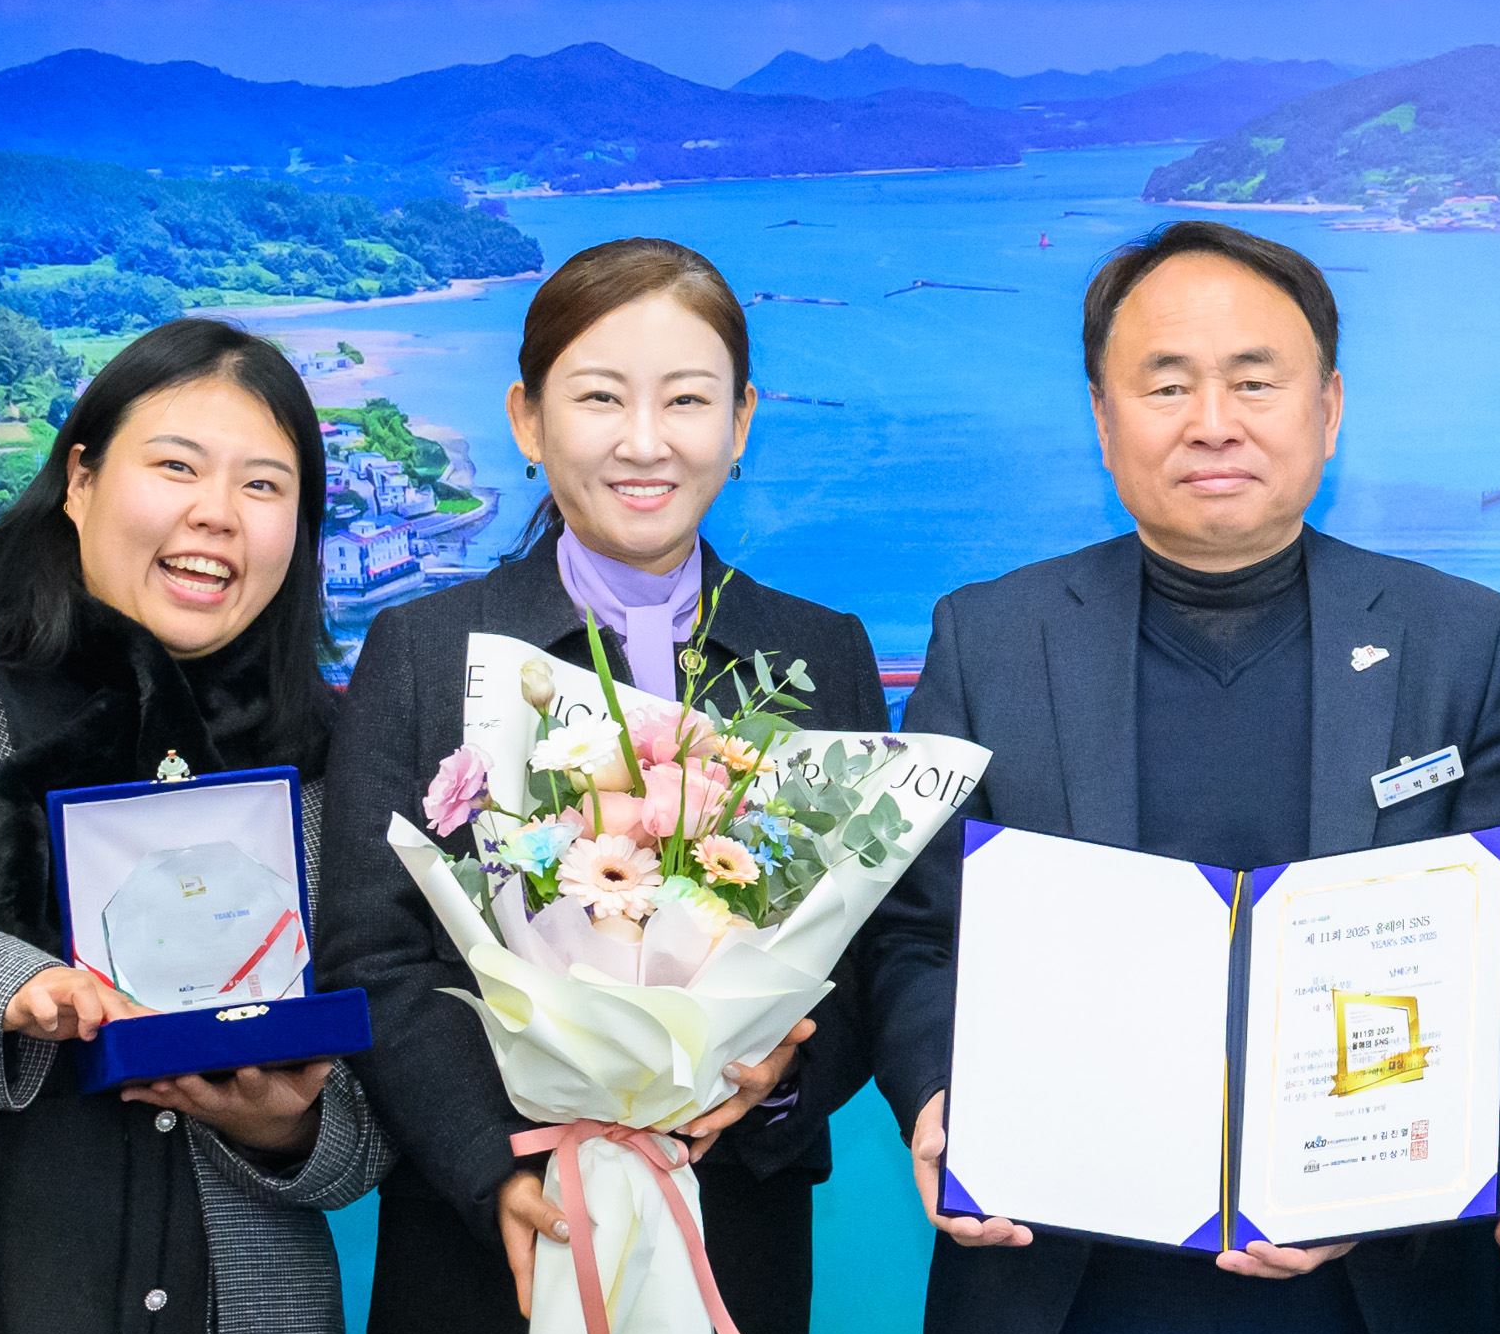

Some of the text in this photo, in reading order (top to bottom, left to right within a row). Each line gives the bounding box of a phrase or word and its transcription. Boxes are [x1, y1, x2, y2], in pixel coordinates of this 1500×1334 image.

[891, 764, 976, 809] JOIE
[1305, 915, 1430, 945] 제 11회 2025 올해의 SNS
[1400, 935, 1416, 946] SNS
[1419, 931, 1437, 942] 2025
[1377, 1026, 1395, 1036] 2025
